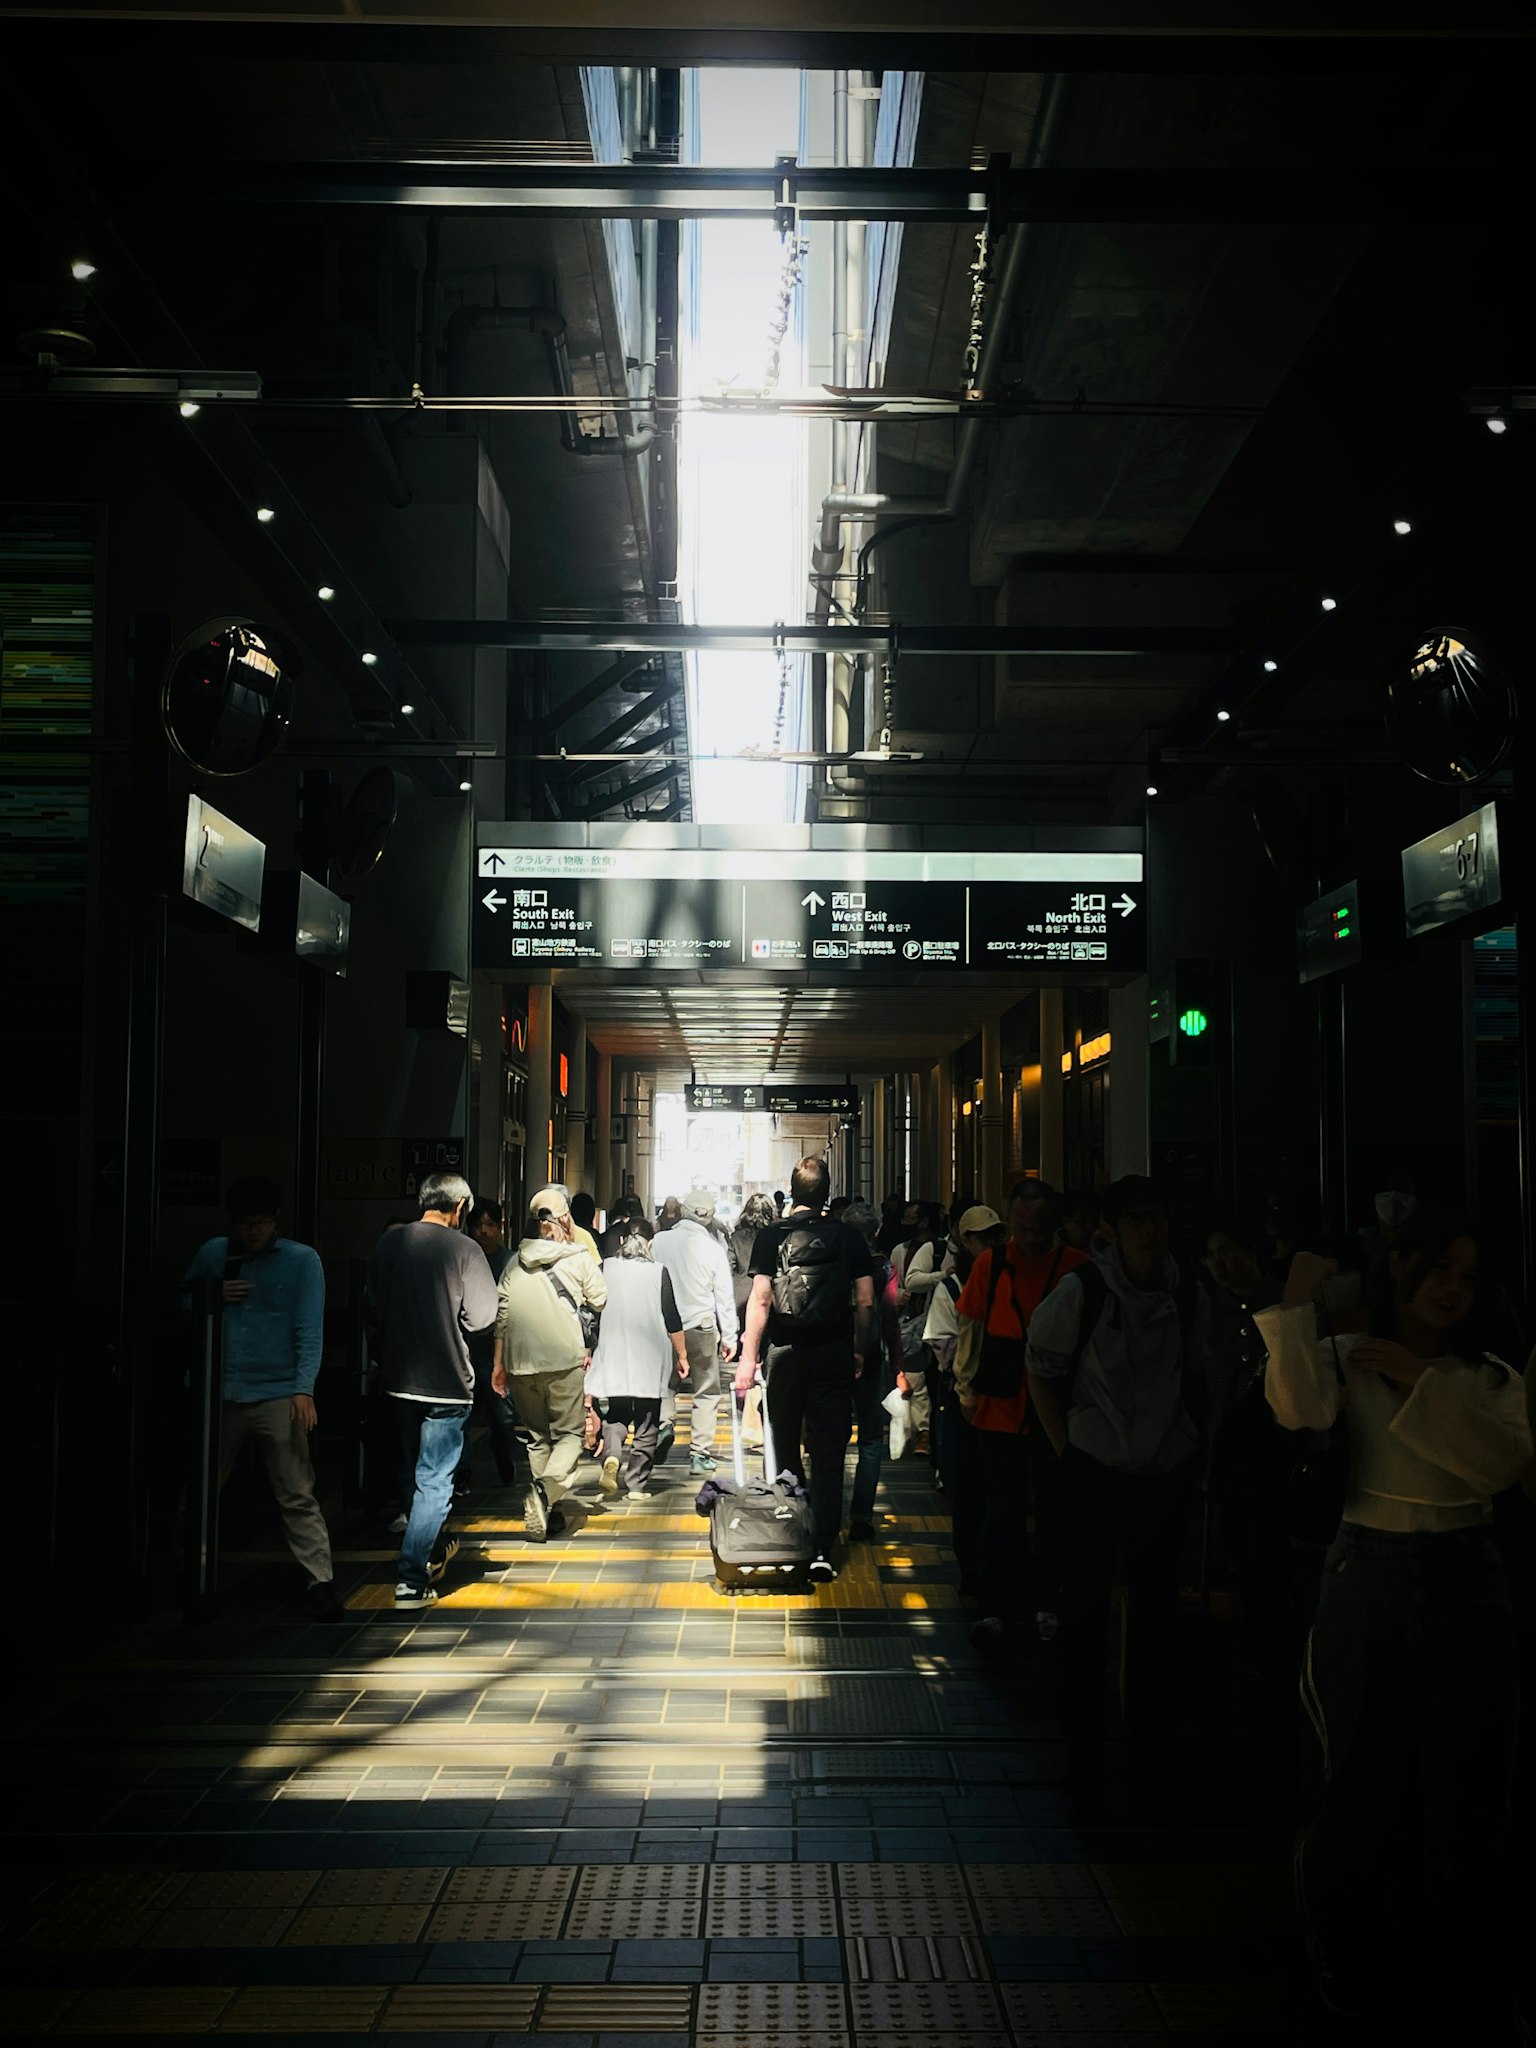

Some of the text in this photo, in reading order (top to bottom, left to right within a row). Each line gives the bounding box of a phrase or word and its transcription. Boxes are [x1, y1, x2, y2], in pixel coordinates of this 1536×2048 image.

[513, 889, 548, 907] 南口
[831, 891, 866, 910] 西口
[1070, 893, 1106, 911] 北口
[512, 908, 575, 920] South Exit
[832, 910, 888, 922] West Exit
[1045, 912, 1107, 923] North Exit
[907, 943, 919, 956] P
